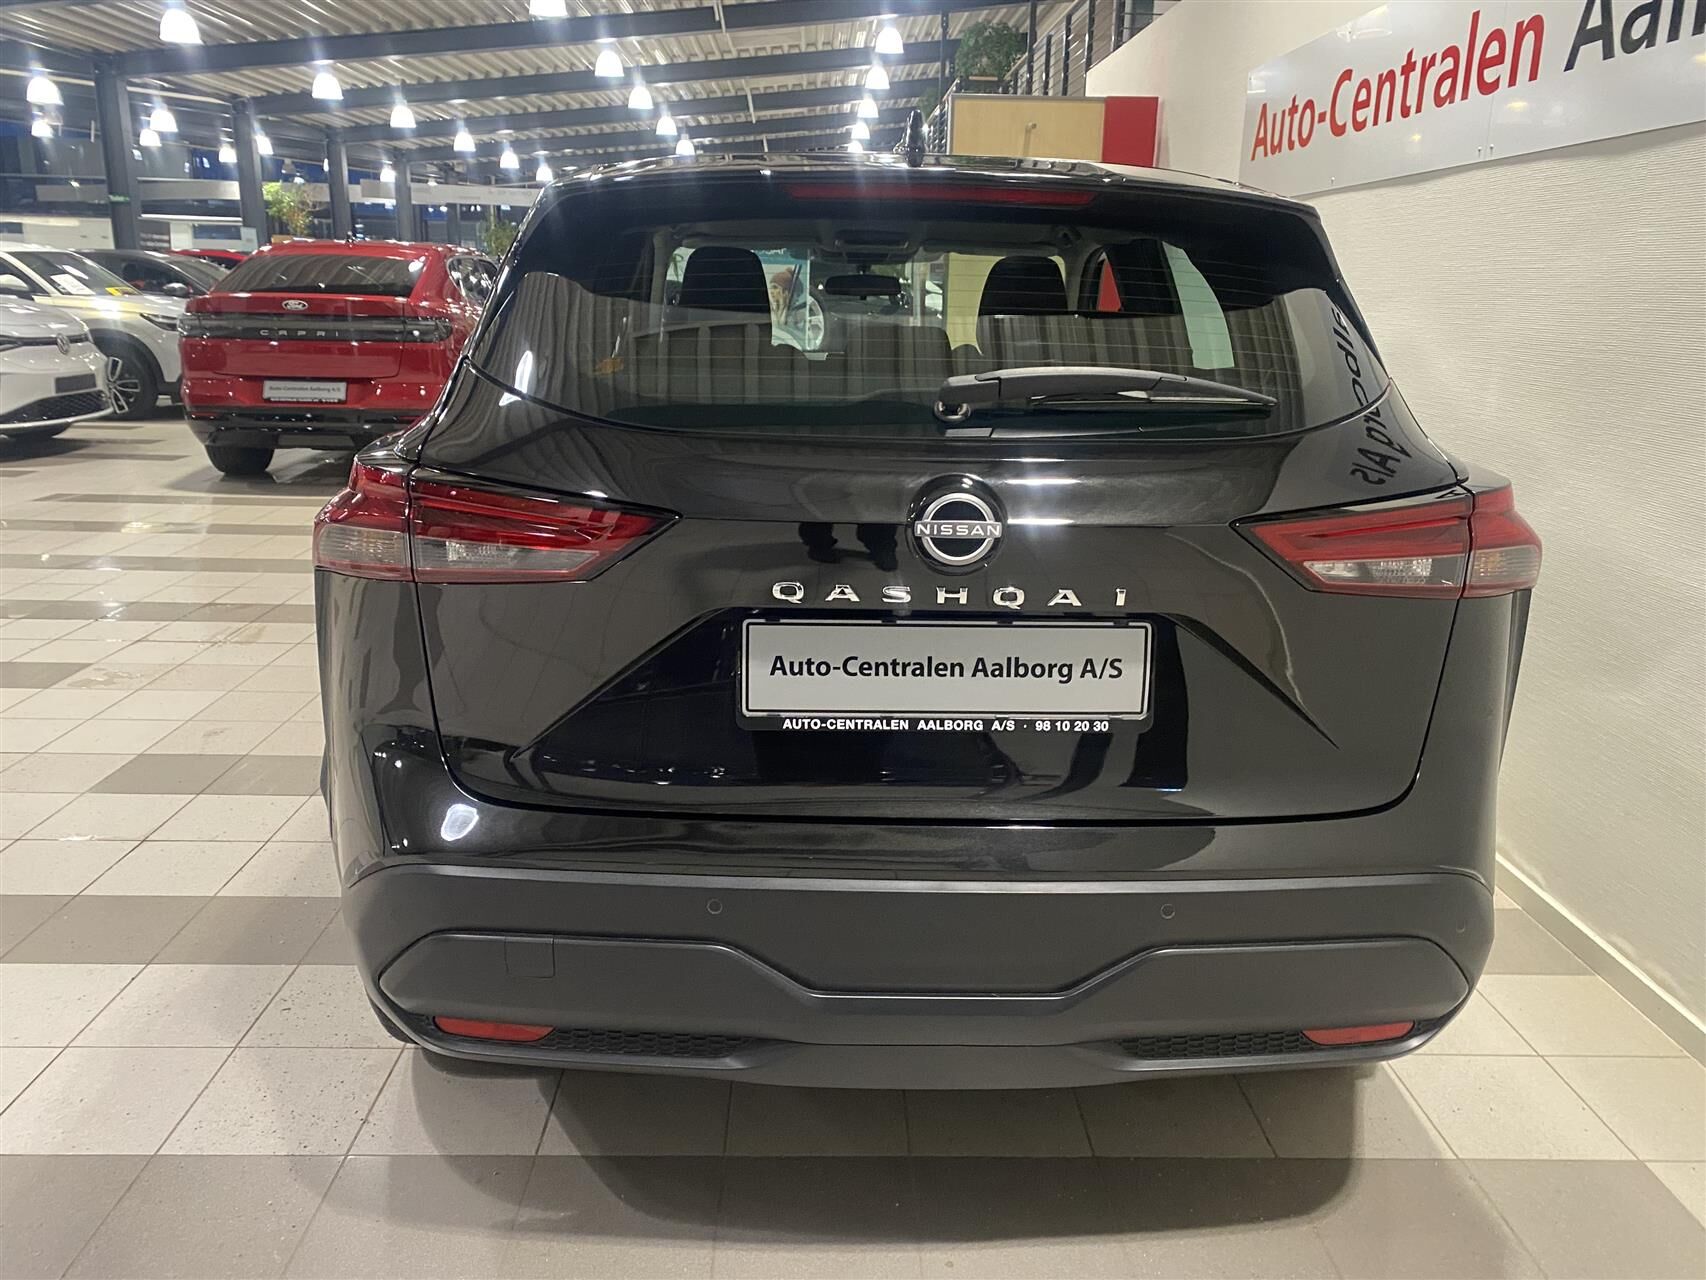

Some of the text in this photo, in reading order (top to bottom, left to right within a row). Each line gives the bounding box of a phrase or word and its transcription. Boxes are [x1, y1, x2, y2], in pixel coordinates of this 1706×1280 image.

[1251, 0, 1706, 161] Auto-Centralen Aa
[260, 329, 339, 337] CAPRI
[916, 524, 1000, 536] NISSAN
[771, 581, 1128, 610] QASHQAI
[769, 655, 1123, 684] Auto-Centralen Aalborg A/S
[782, 718, 1109, 732] AUTO-CENTRALEN AALBORG A/S 98 10 20 30
